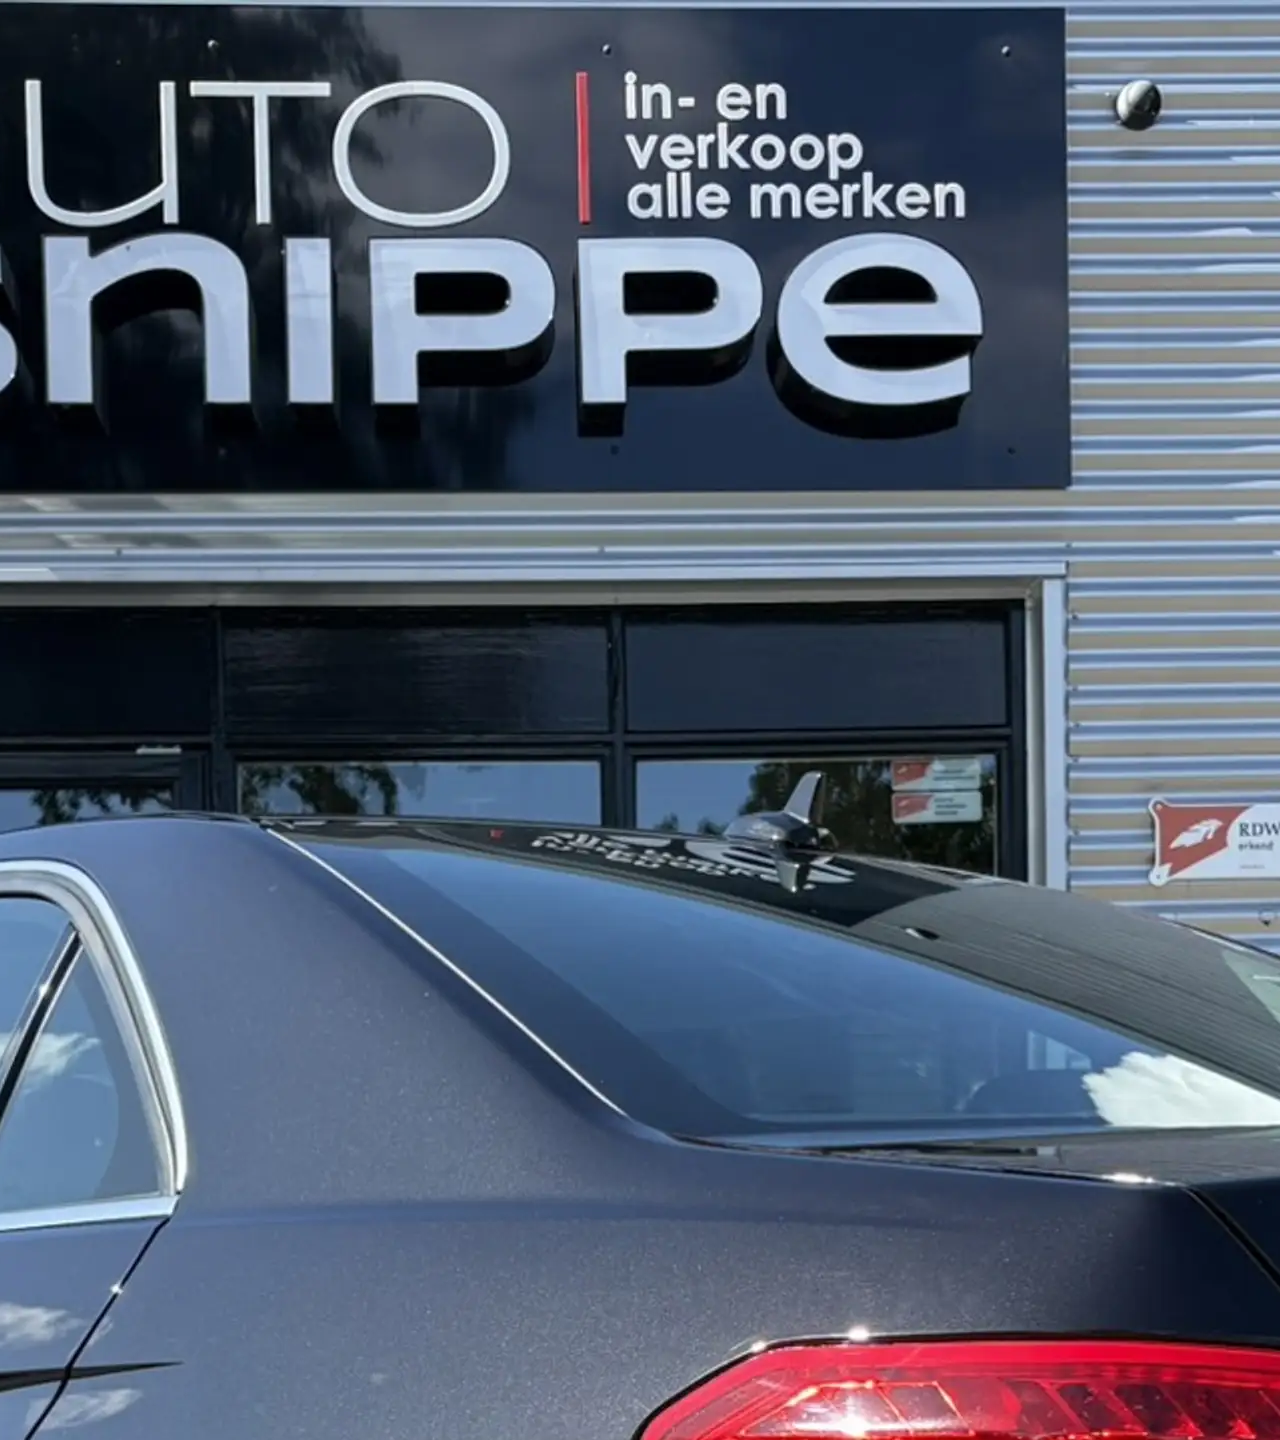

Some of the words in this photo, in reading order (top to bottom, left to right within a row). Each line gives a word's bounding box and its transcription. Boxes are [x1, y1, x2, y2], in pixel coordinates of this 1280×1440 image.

[624, 71, 695, 119] in-
[716, 82, 787, 120] en
[625, 122, 863, 180] verkoop
[626, 171, 731, 219] alle
[750, 171, 966, 219] merken
